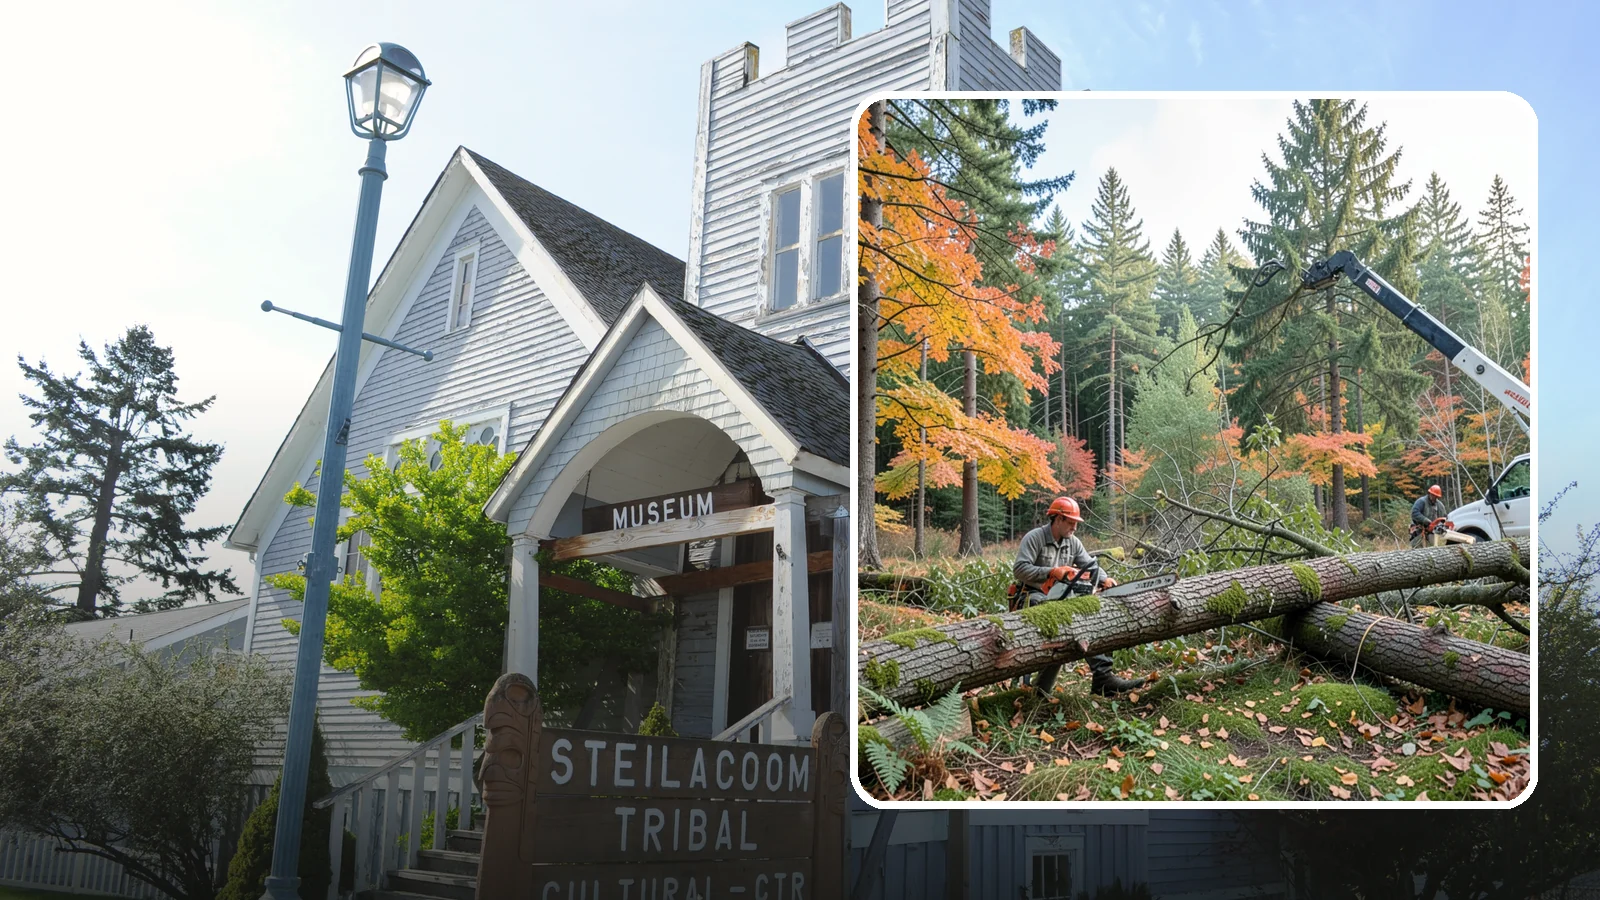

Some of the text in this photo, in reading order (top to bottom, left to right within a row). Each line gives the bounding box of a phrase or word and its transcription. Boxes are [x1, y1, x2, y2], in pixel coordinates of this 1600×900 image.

[612, 491, 713, 531] MUSEUM
[550, 738, 810, 793] STEILACOOM
[614, 806, 758, 852] TRIBAL
